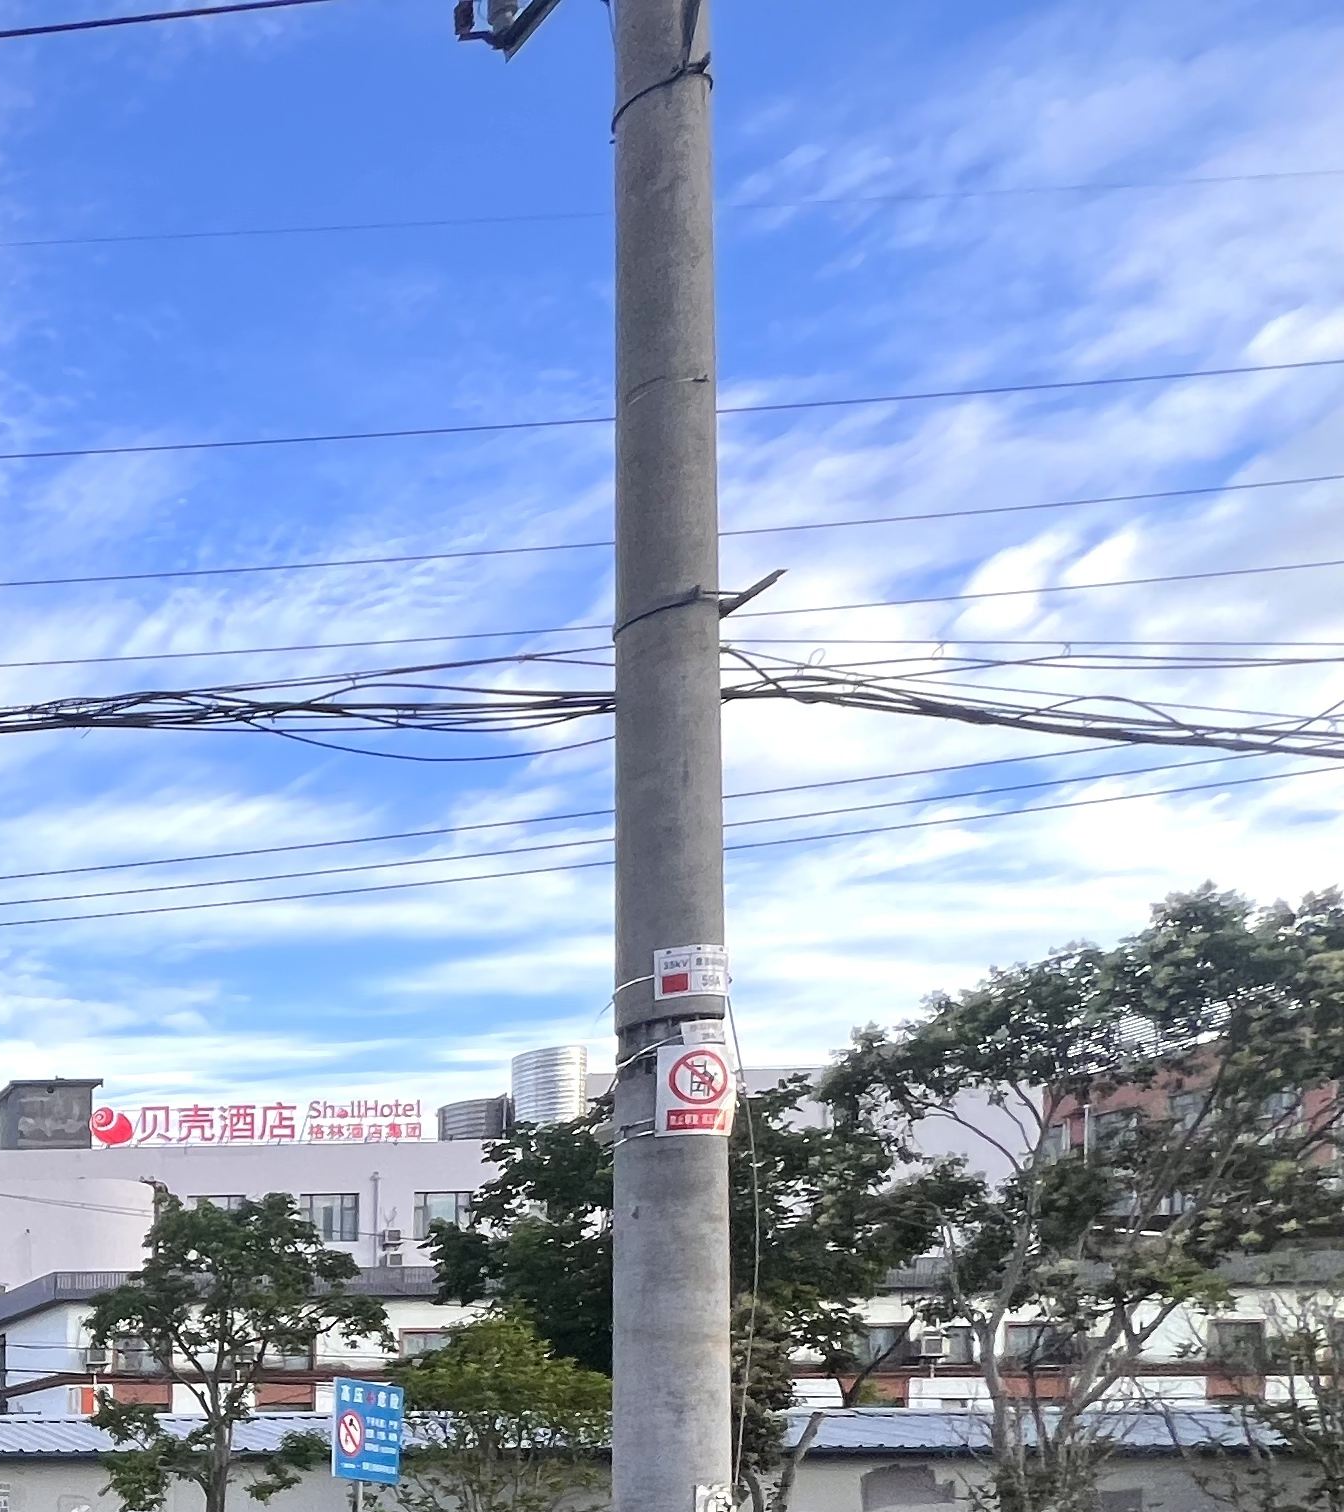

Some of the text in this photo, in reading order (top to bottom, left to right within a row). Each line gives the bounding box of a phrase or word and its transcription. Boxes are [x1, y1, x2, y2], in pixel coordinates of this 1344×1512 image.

[138, 1103, 297, 1142] 贝壳酒店
[308, 1123, 422, 1140] 格林酒店集团
